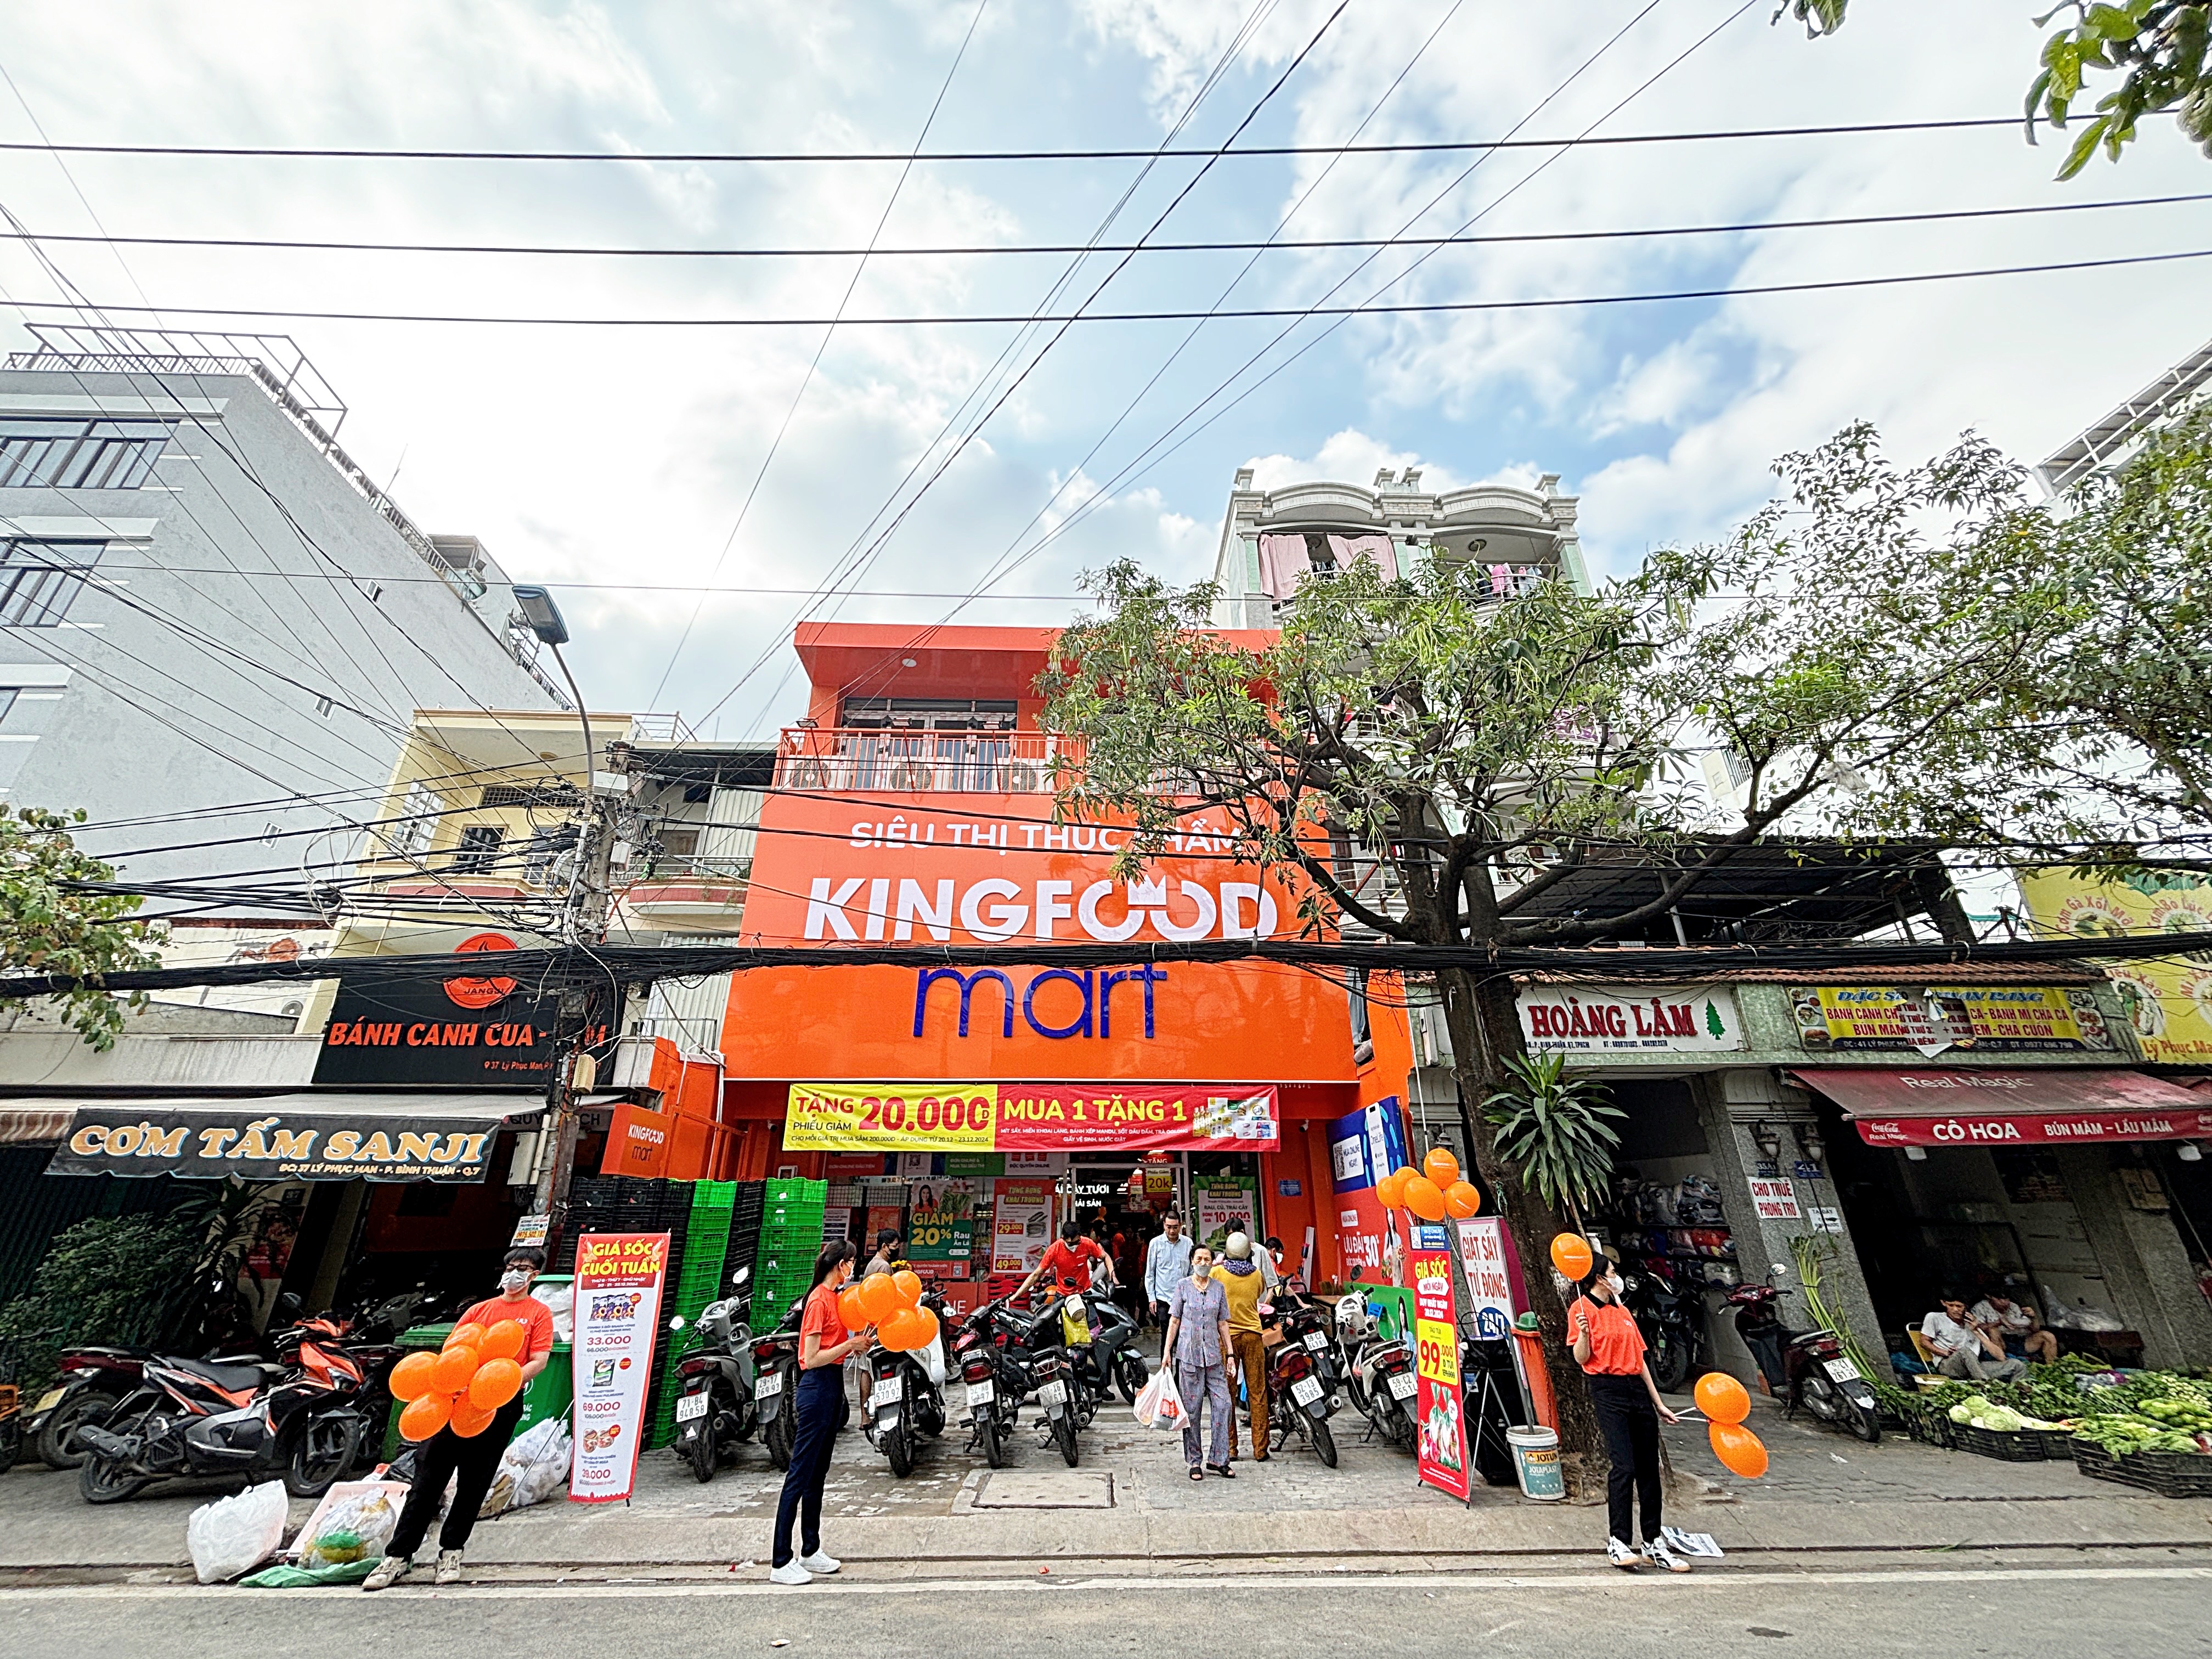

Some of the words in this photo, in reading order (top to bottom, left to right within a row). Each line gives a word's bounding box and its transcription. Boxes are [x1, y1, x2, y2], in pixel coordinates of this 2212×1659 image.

[850, 815, 935, 849] SIÊU
[948, 822, 1008, 856] THỊ
[1019, 821, 1121, 857] THỰC
[803, 875, 1278, 943] KINGFOOD
[913, 963, 1167, 1039] mart
[1528, 996, 1627, 1037] HOÀNG
[1630, 997, 1698, 1037] LÂM
[1826, 1006, 1854, 1019] BÁNH
[1856, 1008, 1882, 1019] CANH
[328, 1016, 401, 1046] BÁNH
[407, 1023, 479, 1047] CANH
[484, 1023, 533, 1047] CUA
[1853, 1022, 1877, 1035] BÚN
[2023, 1020, 2054, 1036] CUỐN
[490, 1062, 499, 1070] 37
[501, 1062, 509, 1071] Lý
[1900, 1076, 1961, 1088] Real
[1956, 1076, 2034, 1089] Magic
[795, 1092, 855, 1118] TẶNG
[1003, 1098, 1065, 1121] MUA
[1073, 1099, 1086, 1121] 1
[1093, 1093, 1164, 1127] TẶNG
[1173, 1100, 1187, 1121] 1
[793, 1118, 823, 1131] PHIẾU
[826, 1120, 851, 1131] GIẢM
[1932, 1119, 1965, 1141] CÔ
[1968, 1122, 2021, 1140] HOA
[2044, 1120, 2072, 1136] BÚN
[2071, 1120, 2104, 1135] MẮM
[2140, 1118, 2174, 1133] MẮM
[69, 1121, 191, 1158] CƠM
[198, 1117, 319, 1161] TẤM
[323, 1132, 490, 1164] SANJI
[628, 1124, 664, 1144] KINGFOOD
[910, 1136, 928, 1144] DỤNG
[298, 1164, 309, 1173] 37
[310, 1162, 323, 1173] LÝ
[323, 1164, 352, 1175] PHỤC
[353, 1164, 378, 1173] MAN
[395, 1163, 419, 1175] BÌNH
[421, 1165, 455, 1176] THUẬN
[462, 1166, 481, 1176] Q.7
[1148, 1178, 1170, 1188] 20k
[1752, 1182, 1770, 1197] CHO
[912, 1207, 954, 1226] GIẢM
[911, 1227, 952, 1246] 20%
[953, 1231, 970, 1239] Rau
[1481, 1225, 1499, 1261] SẤY
[592, 1239, 621, 1256] GIÁ
[623, 1238, 653, 1256] SỐC
[580, 1257, 618, 1276] CUỐI
[620, 1256, 661, 1274] TUẦN
[1415, 1258, 1430, 1280] GIÁ
[1430, 1254, 1448, 1278] SỐC
[1481, 1265, 1508, 1305] ĐỘNG
[1482, 1312, 1505, 1335] 24/7
[586, 1335, 631, 1346] 33.000
[1307, 1333, 1322, 1342] 59-C2
[759, 1375, 778, 1388] 29-Y7
[1295, 1379, 1315, 1394] 52-T3
[1392, 1375, 1412, 1389] 59-C2
[757, 1383, 780, 1398] 269.93
[1300, 1387, 1319, 1403] 3985
[583, 1401, 620, 1412] 69.000
[682, 1396, 703, 1409] 71-B4
[679, 1405, 704, 1420] 948.58
